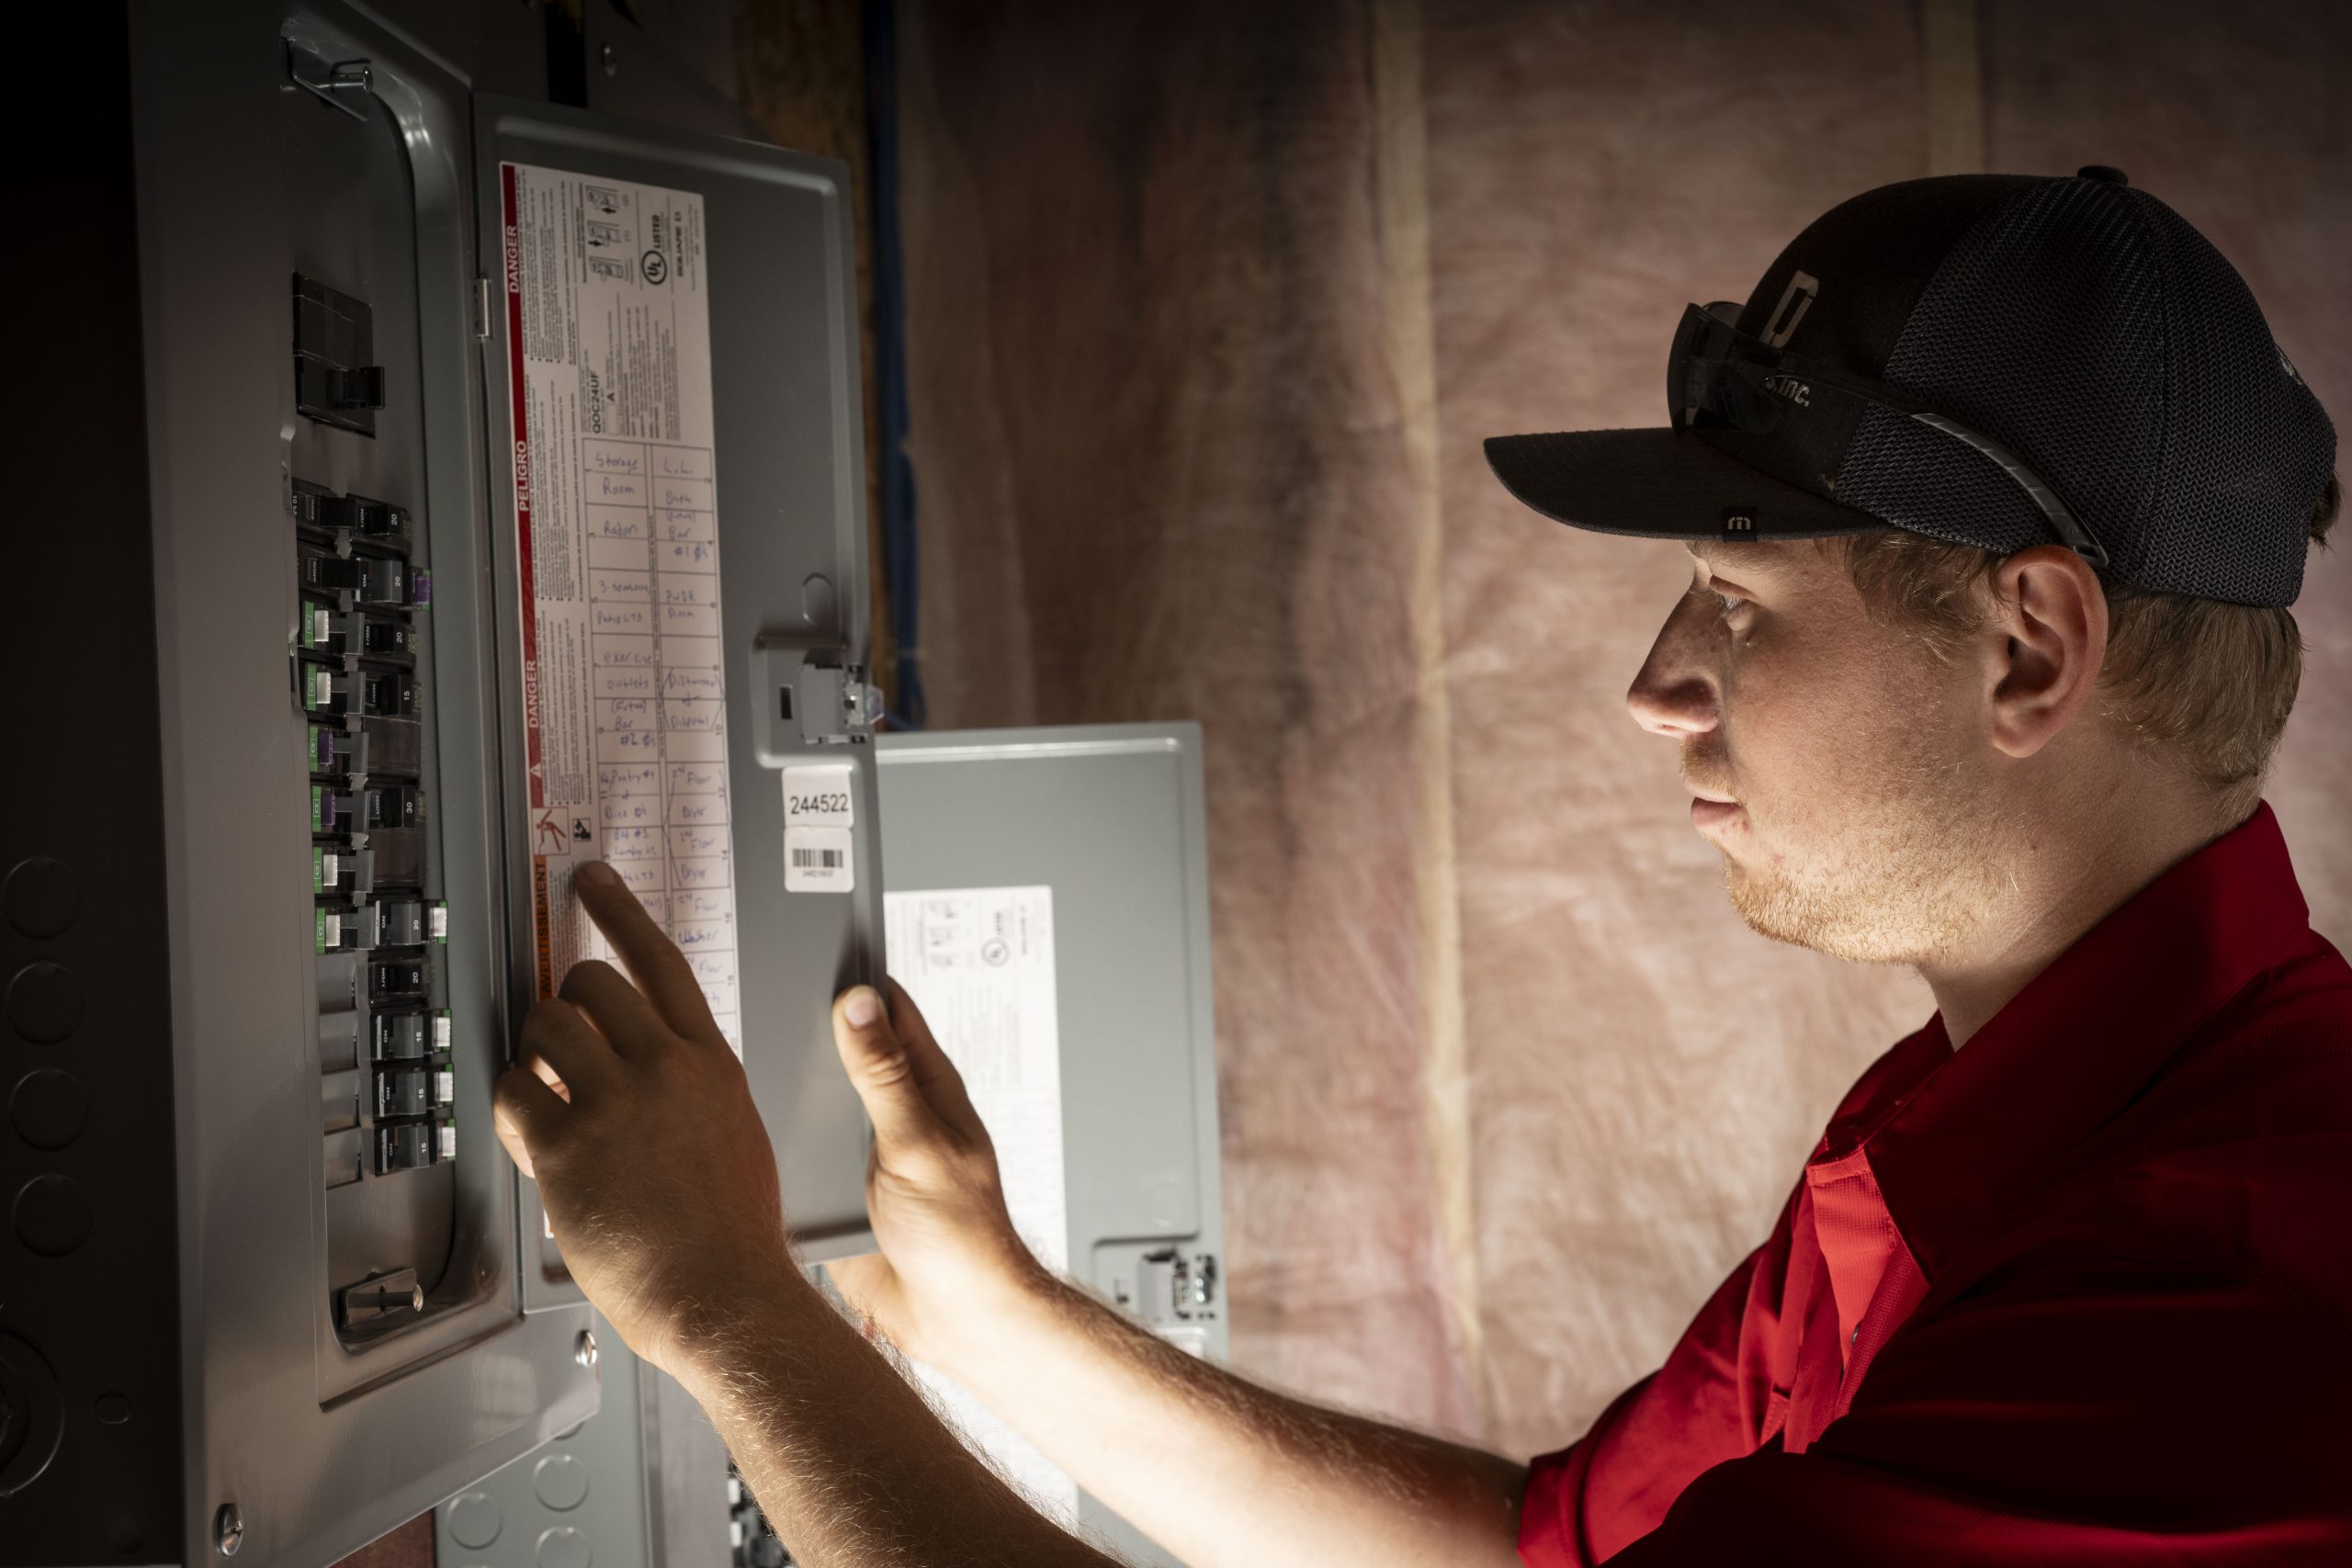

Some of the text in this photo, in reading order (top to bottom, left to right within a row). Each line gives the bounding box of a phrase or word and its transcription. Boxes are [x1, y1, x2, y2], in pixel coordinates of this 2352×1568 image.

[509, 226, 519, 293] DANGER
[647, 260, 662, 277] UL
[593, 371, 602, 434] QOC24UF
[606, 392, 615, 402] A
[516, 441, 530, 512] PELIGRO
[390, 513, 398, 525] 20
[394, 575, 401, 588] 20
[396, 631, 403, 644] 20
[403, 690, 411, 701] 15
[526, 660, 539, 728] DANGER
[406, 801, 413, 814] 30
[790, 794, 849, 815] 244522
[413, 919, 419, 931] 20
[535, 862, 550, 994] AVERTISSEMENT
[412, 972, 419, 984] 20
[415, 1032, 423, 1043] 15
